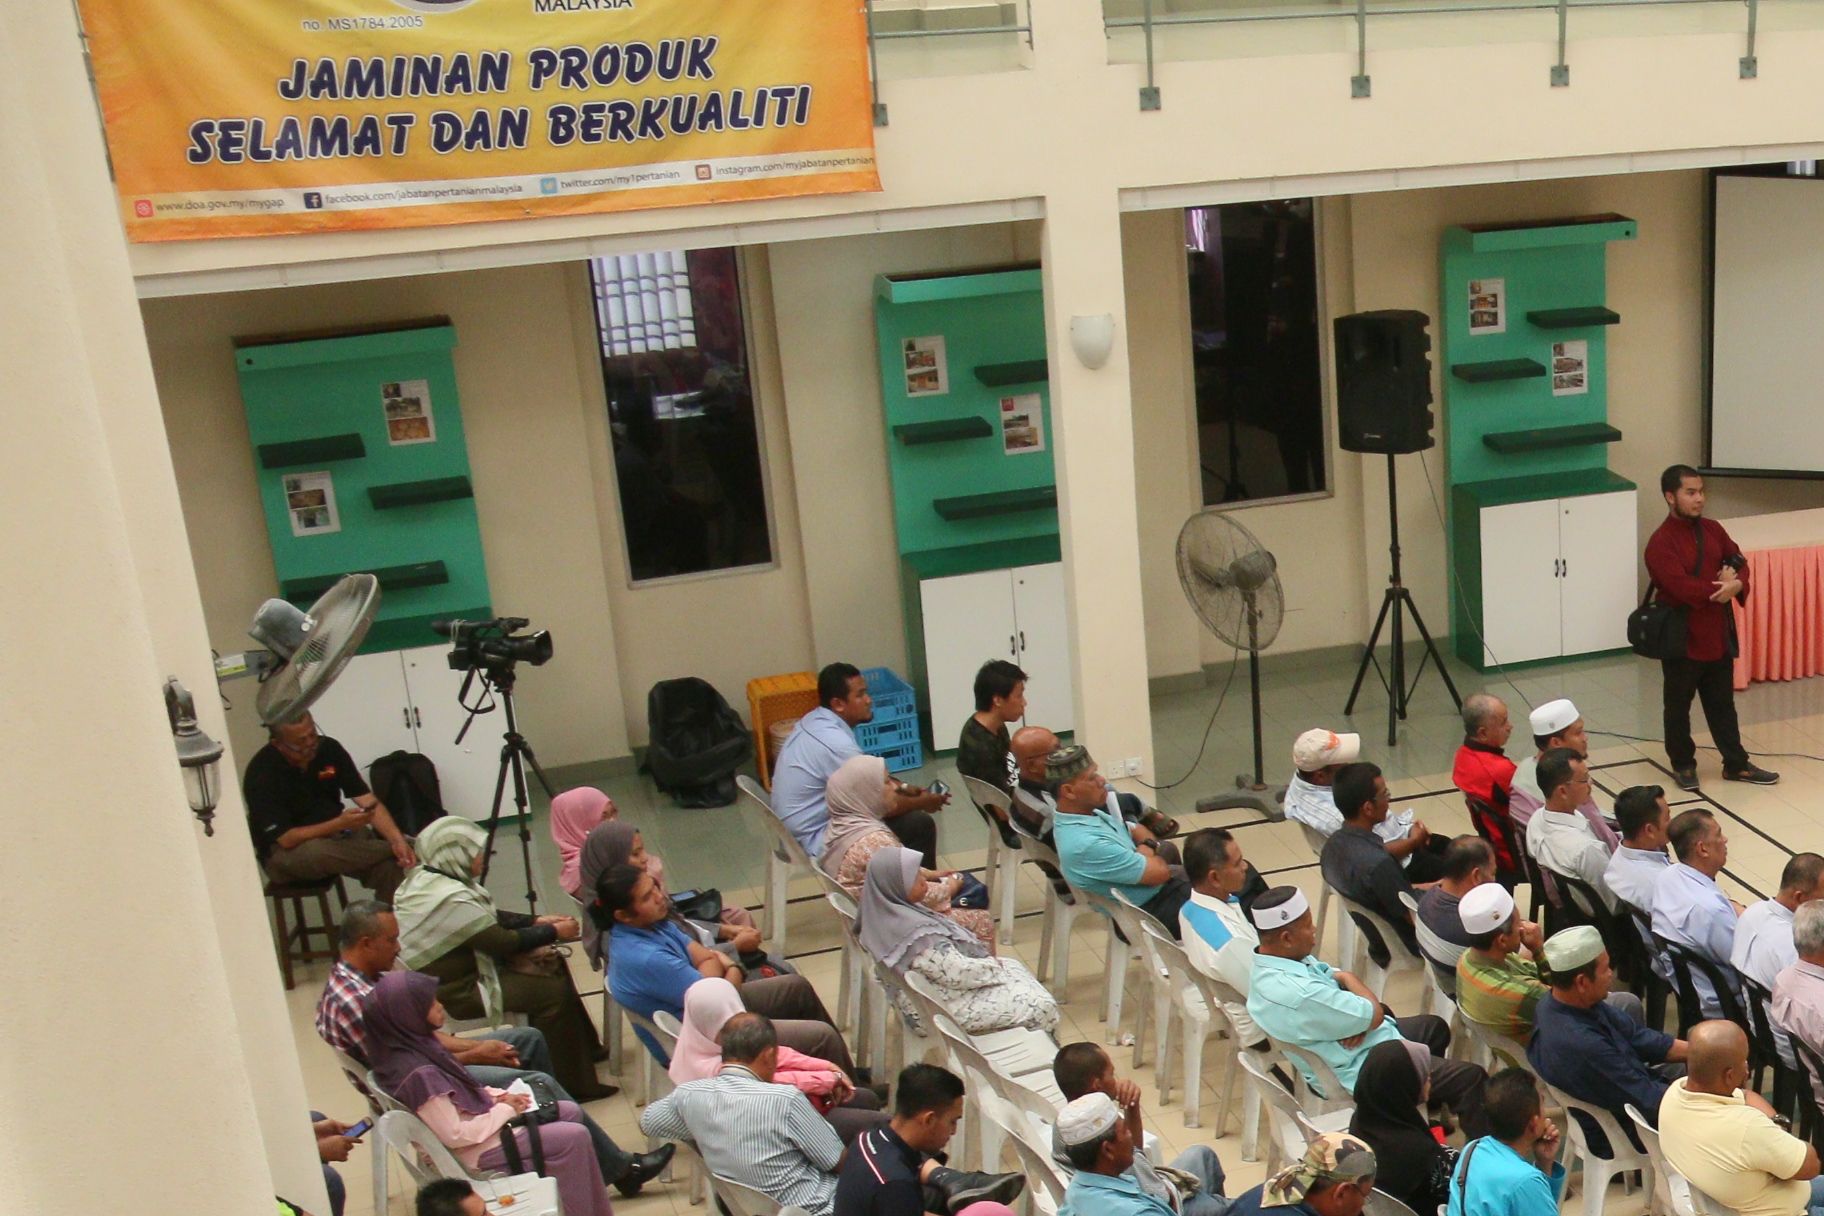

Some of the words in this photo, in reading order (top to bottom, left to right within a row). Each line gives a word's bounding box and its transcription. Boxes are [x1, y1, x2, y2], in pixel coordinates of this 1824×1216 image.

[280, 53, 509, 98] JAMINAN
[529, 37, 718, 90] PRODUK
[188, 114, 413, 164] SELAMAT
[431, 108, 531, 152] DAN
[550, 86, 811, 145] BERKUALITI
